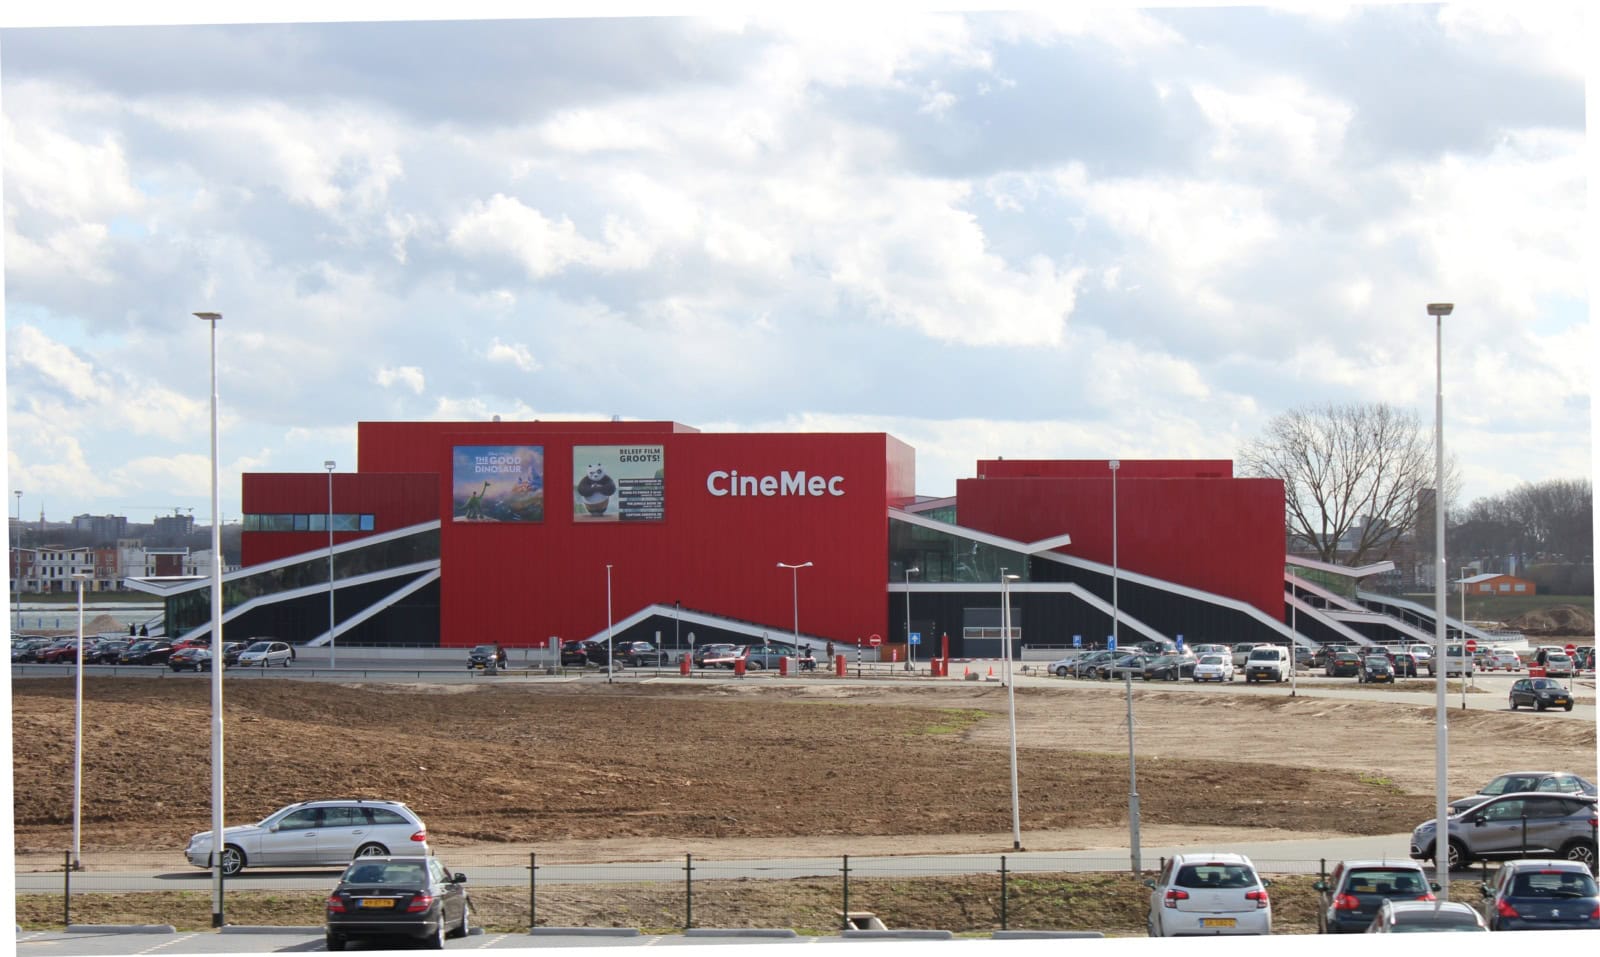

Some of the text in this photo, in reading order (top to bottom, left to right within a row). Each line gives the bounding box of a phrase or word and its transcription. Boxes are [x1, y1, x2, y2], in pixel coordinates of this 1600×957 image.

[475, 456, 521, 465] THE GOOD
[619, 454, 661, 463] GROOTS!
[474, 465, 521, 473] DINOSAUR
[706, 469, 846, 497] CineMec
